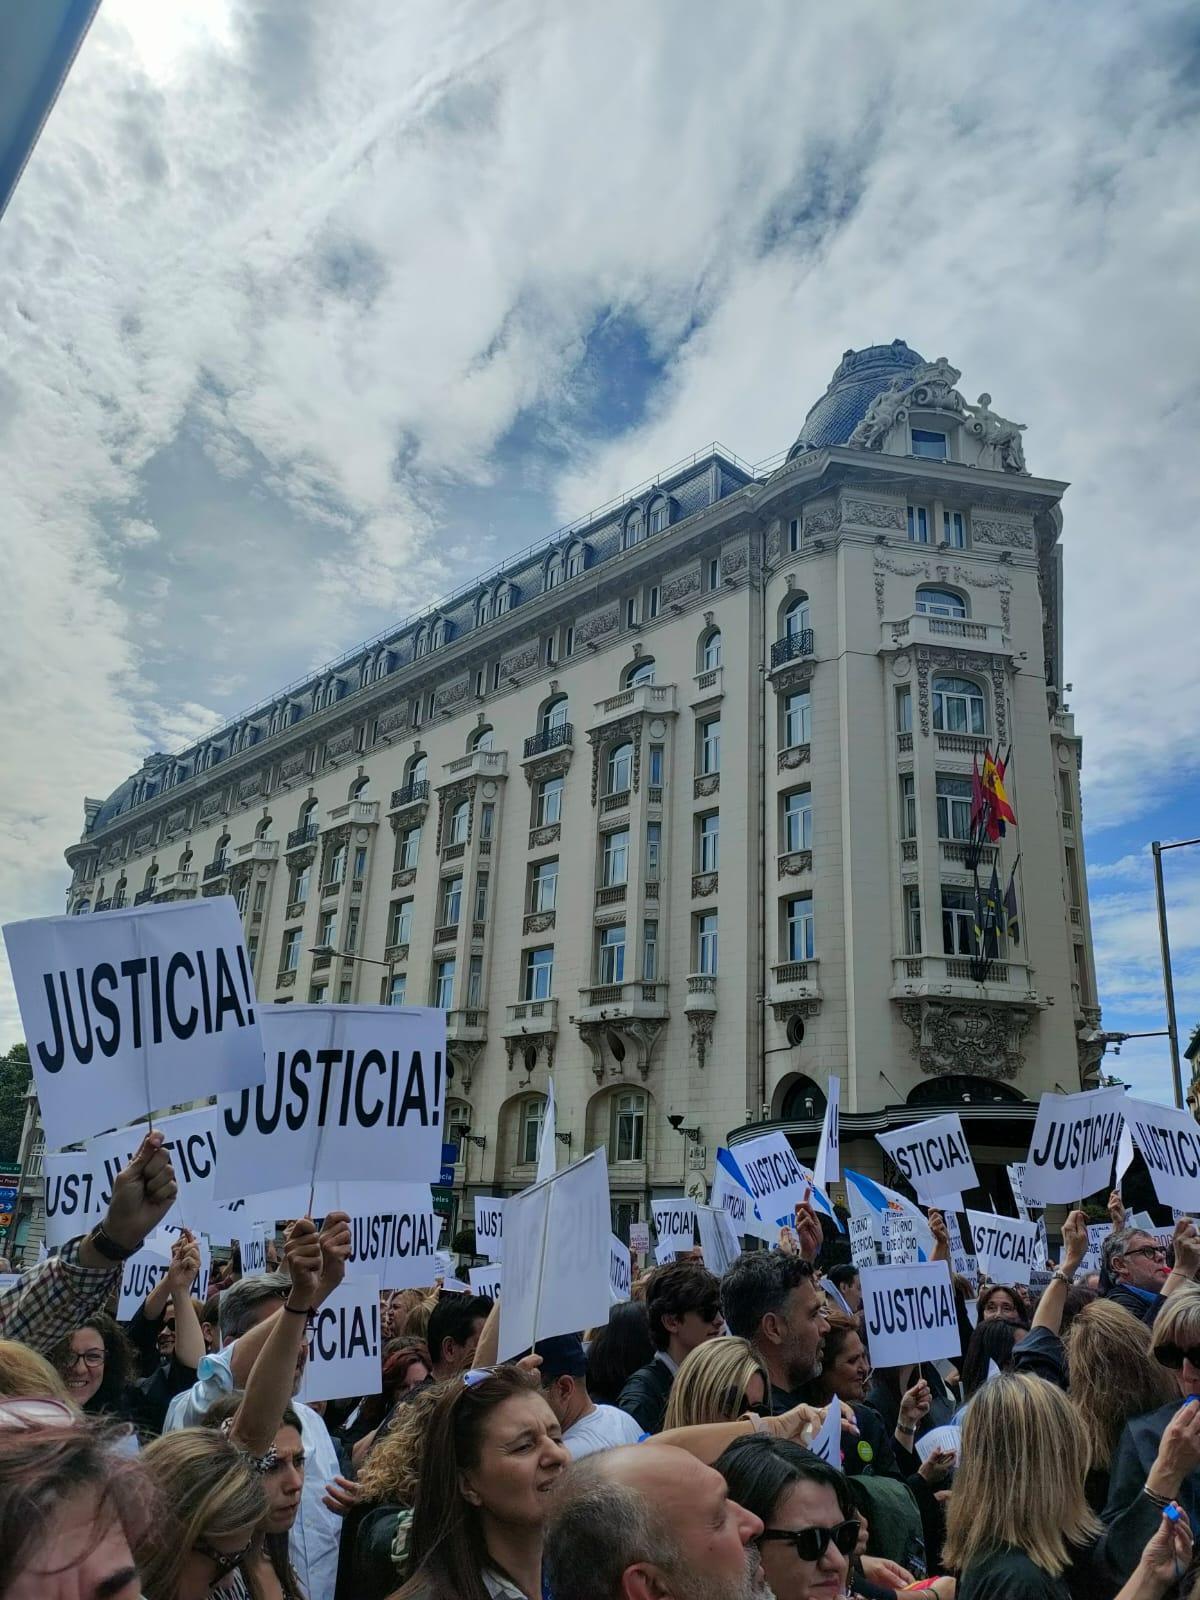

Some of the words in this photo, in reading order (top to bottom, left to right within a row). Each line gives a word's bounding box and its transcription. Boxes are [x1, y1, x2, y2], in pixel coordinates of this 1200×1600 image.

[36, 945, 256, 1074] JUSTICIA!
[889, 1130, 970, 1180] STICIA!
[1034, 1111, 1121, 1171] JUSTICIA!
[1135, 1121, 1200, 1178] JUSTICI
[45, 1173, 101, 1217] UST
[349, 1212, 435, 1264] JUSTICIA!
[653, 1210, 694, 1235] STICIA!
[971, 1225, 1033, 1265] STICIA!
[869, 1283, 957, 1336] JUSTICIA!
